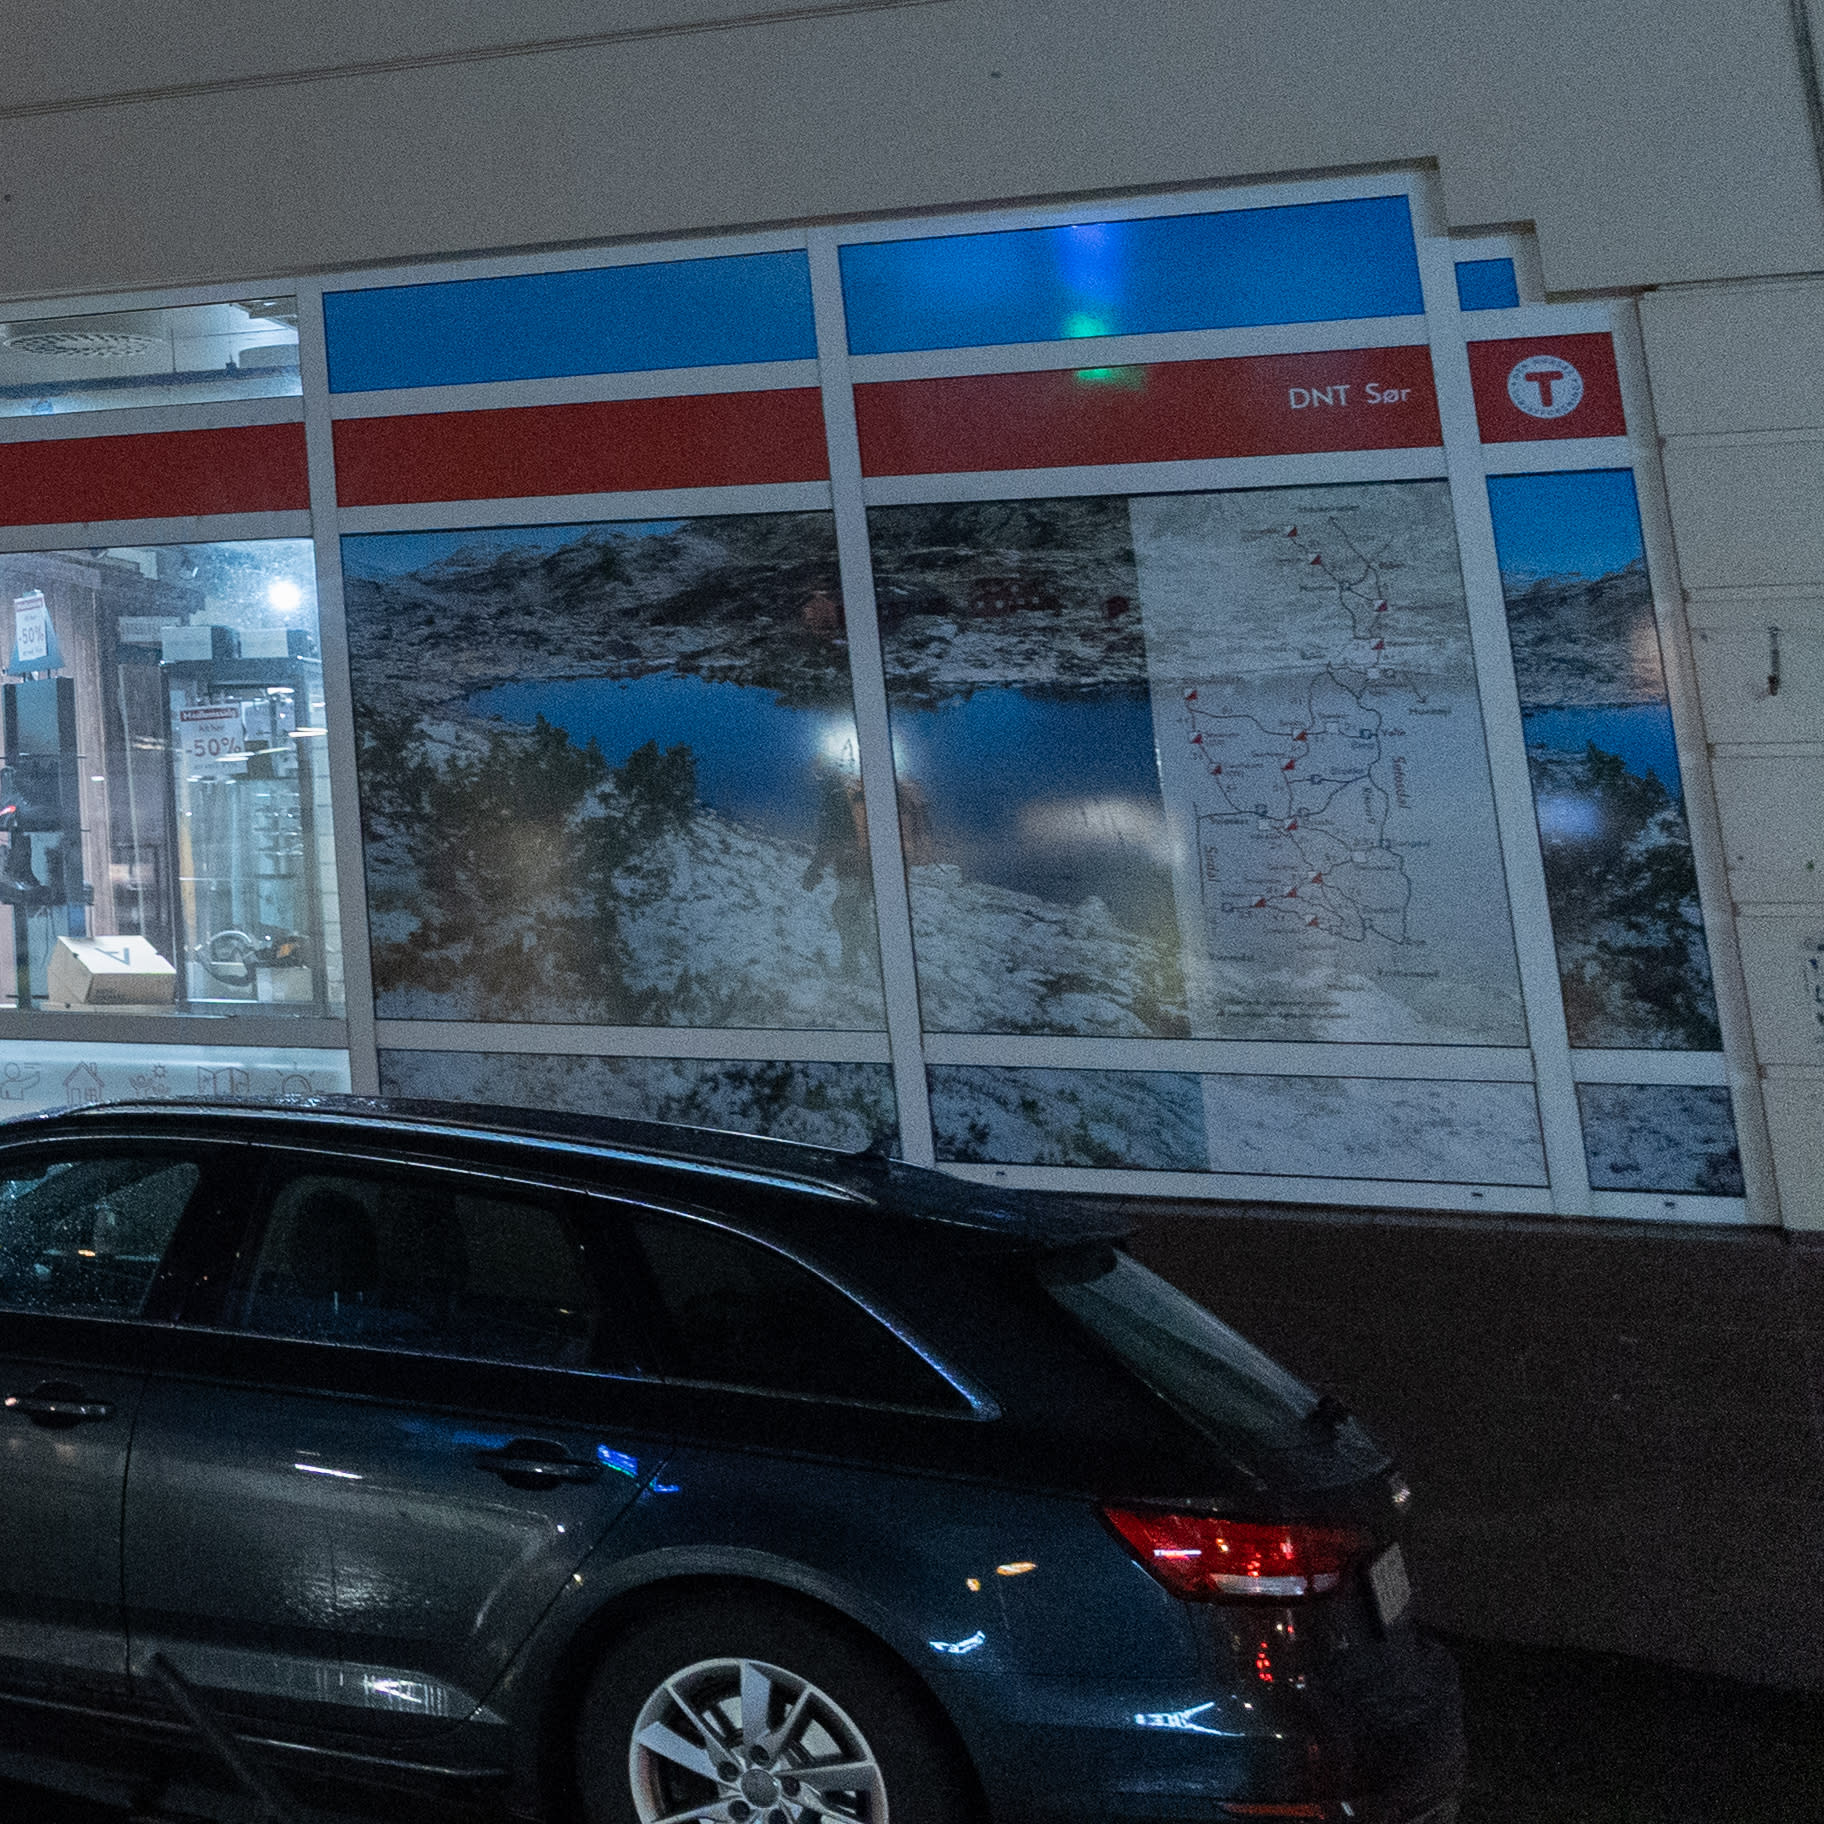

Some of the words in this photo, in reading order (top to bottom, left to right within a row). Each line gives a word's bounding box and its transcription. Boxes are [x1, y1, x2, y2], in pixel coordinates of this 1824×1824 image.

[1289, 383, 1351, 411] DNT
[1364, 381, 1411, 407] Sør
[1524, 370, 1564, 409] T
[185, 736, 242, 758] -50%
